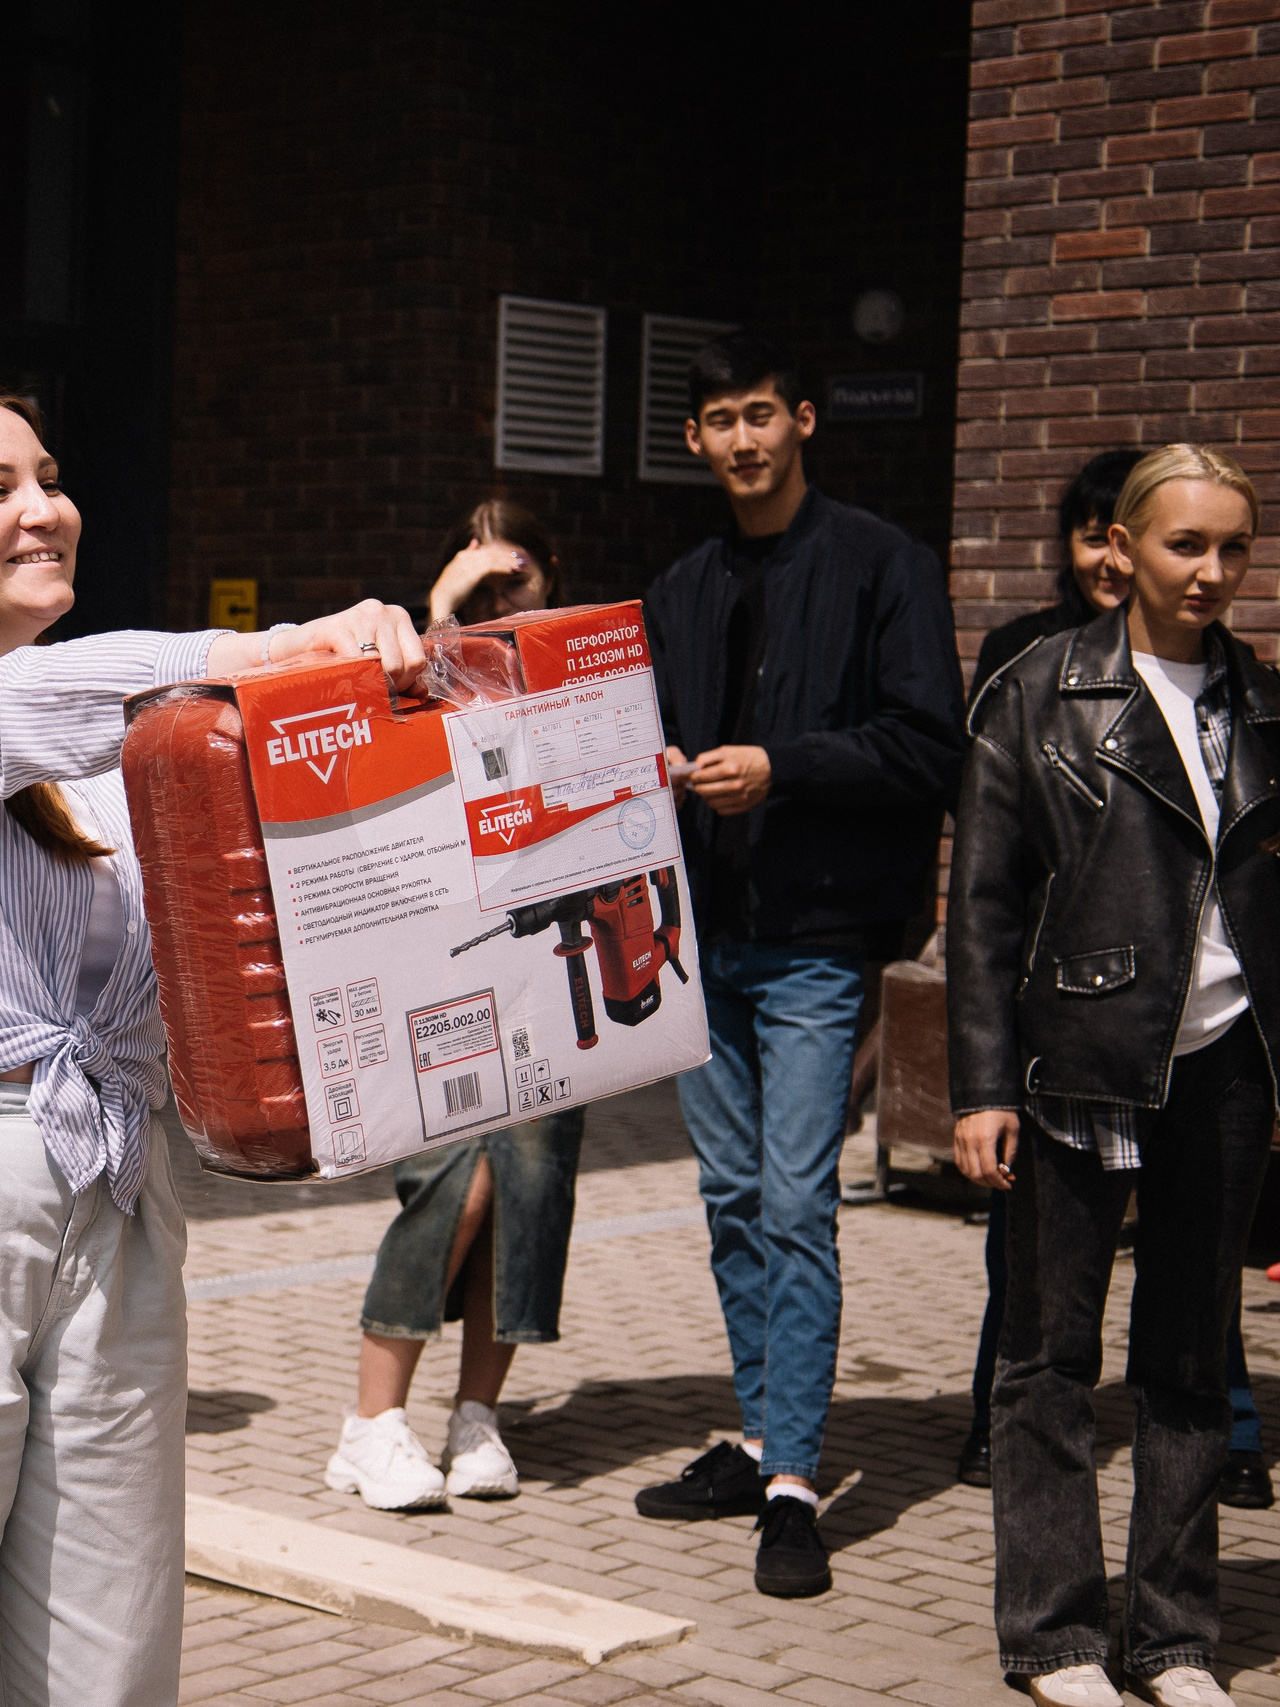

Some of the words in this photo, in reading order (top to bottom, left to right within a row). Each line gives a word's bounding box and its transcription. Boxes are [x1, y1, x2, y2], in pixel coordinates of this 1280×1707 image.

[566, 625, 639, 652] ПЕРФОРАТОР
[566, 659, 576, 672] П
[578, 647, 625, 670] 1130ЭМ
[627, 644, 643, 658] HD
[504, 697, 571, 721] ГАРАНТИЙНЫЙ
[574, 690, 604, 705] ТАЛОН
[266, 719, 372, 766] ELITECH
[478, 808, 533, 836] ELITECH
[293, 857, 341, 875] ВЕРТИКАЛЬНОЕ
[341, 844, 390, 863] РАСПОЛОЖЕНИЕ
[391, 836, 424, 851] ДВИГАТЕЛЯ
[296, 881, 301, 889] 2
[301, 874, 329, 888] РЕЖИМА
[329, 868, 355, 882] РАБОТЫ
[357, 858, 394, 875] (СВЕРЛЕНИЕ
[394, 856, 400, 864] С
[400, 849, 426, 863] УДАРОМ,
[426, 840, 460, 856] ОТБОЙНЫЙ
[300, 893, 367, 917] АНТИВИБРАЦИОННАЯ
[367, 885, 401, 900] ОСНОВНАЯ
[401, 877, 432, 891] РУКОЯТКА
[303, 889, 331, 902] РЕЖИМА
[332, 880, 365, 895] СКОРОСТИ
[365, 871, 400, 886] ВРАЩЕНИЯ
[302, 912, 353, 931] СВЕТОДИОДНЫЙ
[353, 902, 390, 918] ИНДИКАТОР
[391, 892, 429, 908] ВКЛЮЧЕНИЯ
[429, 890, 434, 898] В
[434, 887, 450, 897] СЕТЬ
[305, 927, 353, 945] РЕГУЛИРУЕМАЯ
[353, 913, 409, 933] ДОПОЛНИТЕЛЬНАЯ
[409, 904, 440, 918] РУКОЯТКА
[632, 951, 652, 968] ELITECH
[354, 1008, 365, 1018] 30
[365, 1006, 378, 1015] мм
[573, 976, 590, 1029] ELITECH
[415, 1008, 491, 1040] E2205.002.00
[323, 1060, 337, 1072] 3,5
[338, 1058, 350, 1069] Дж
[326, 1047, 341, 1056] удара
[328, 1082, 352, 1094] Двойная
